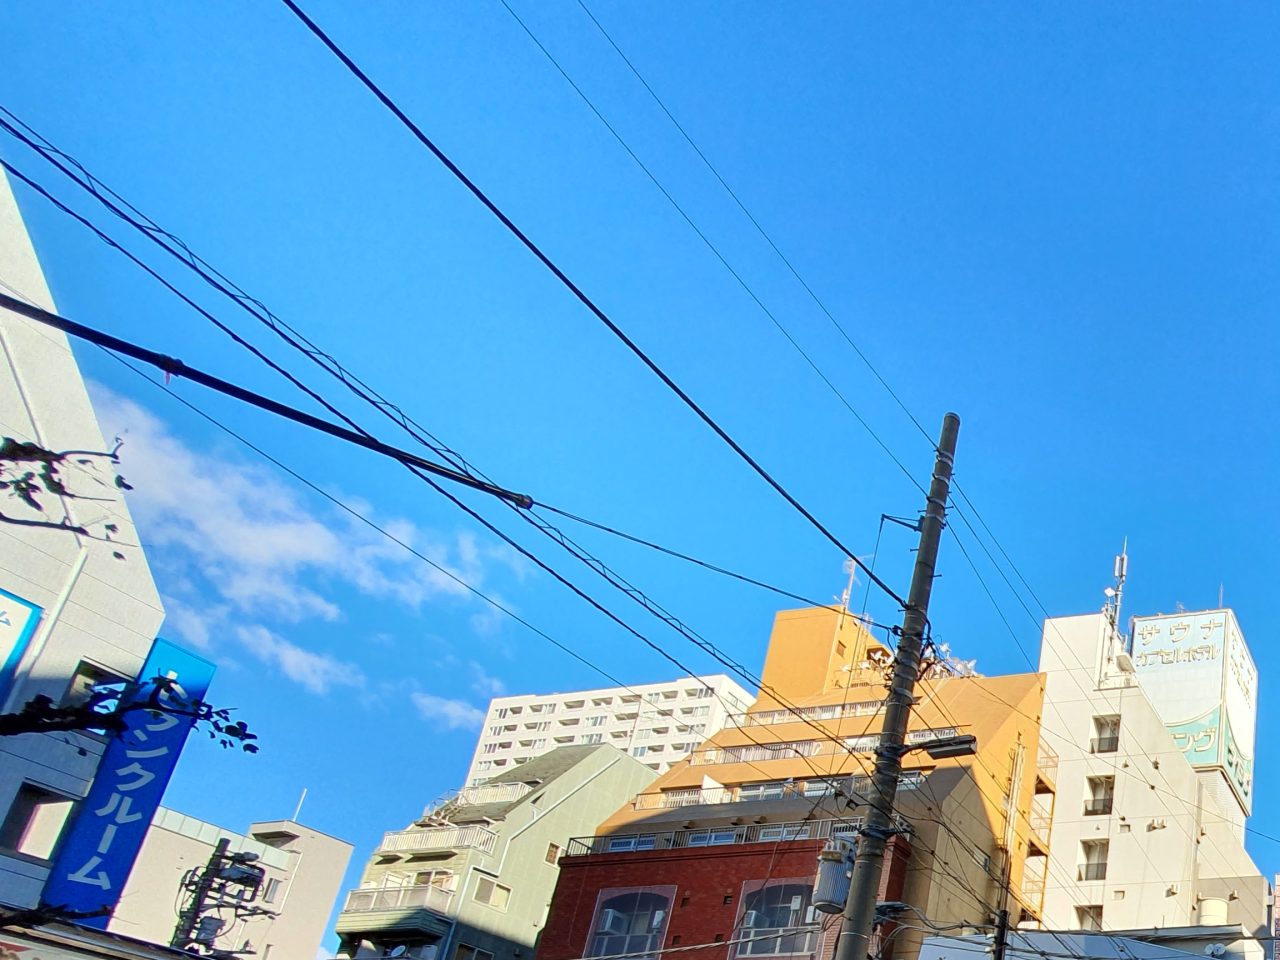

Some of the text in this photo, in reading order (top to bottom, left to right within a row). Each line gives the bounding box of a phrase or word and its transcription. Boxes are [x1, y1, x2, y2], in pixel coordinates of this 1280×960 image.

[1138, 619, 1223, 646] サウナ
[1136, 643, 1220, 667] カプセルホテル
